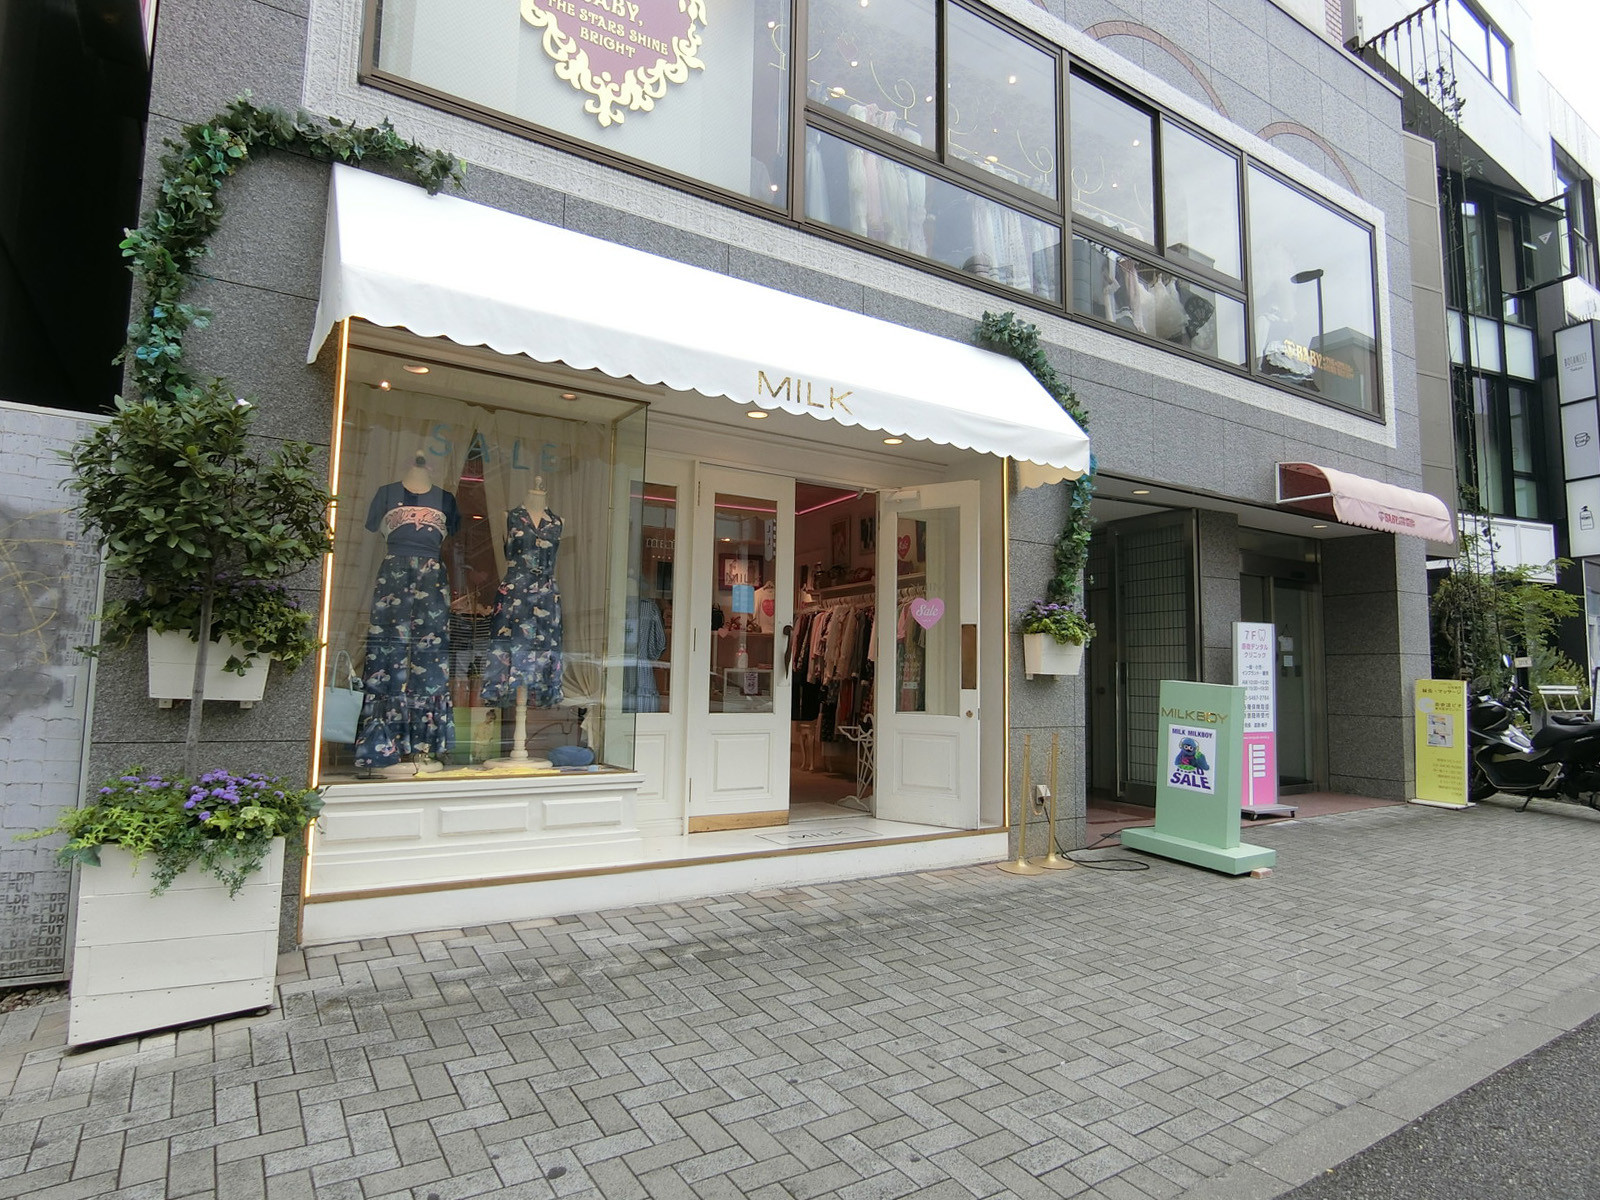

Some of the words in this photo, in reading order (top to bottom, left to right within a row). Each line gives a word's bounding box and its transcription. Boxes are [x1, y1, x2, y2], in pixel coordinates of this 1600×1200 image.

[584, 0, 645, 27] ABY,
[579, 8, 625, 37] STARS
[629, 29, 669, 55] SHINE
[579, 26, 636, 58] BRIGHT
[758, 370, 854, 416] MILK
[428, 423, 562, 473] SALE
[915, 604, 939, 617] Sale
[1161, 707, 1229, 724] MILKBOY
[1172, 728, 1186, 736] MILK
[1187, 730, 1213, 739] MILKBOY
[1170, 772, 1212, 790] SALE
[32, 914, 65, 925] ELDR
[39, 925, 65, 935] FUT
[29, 937, 63, 948] ELDR
